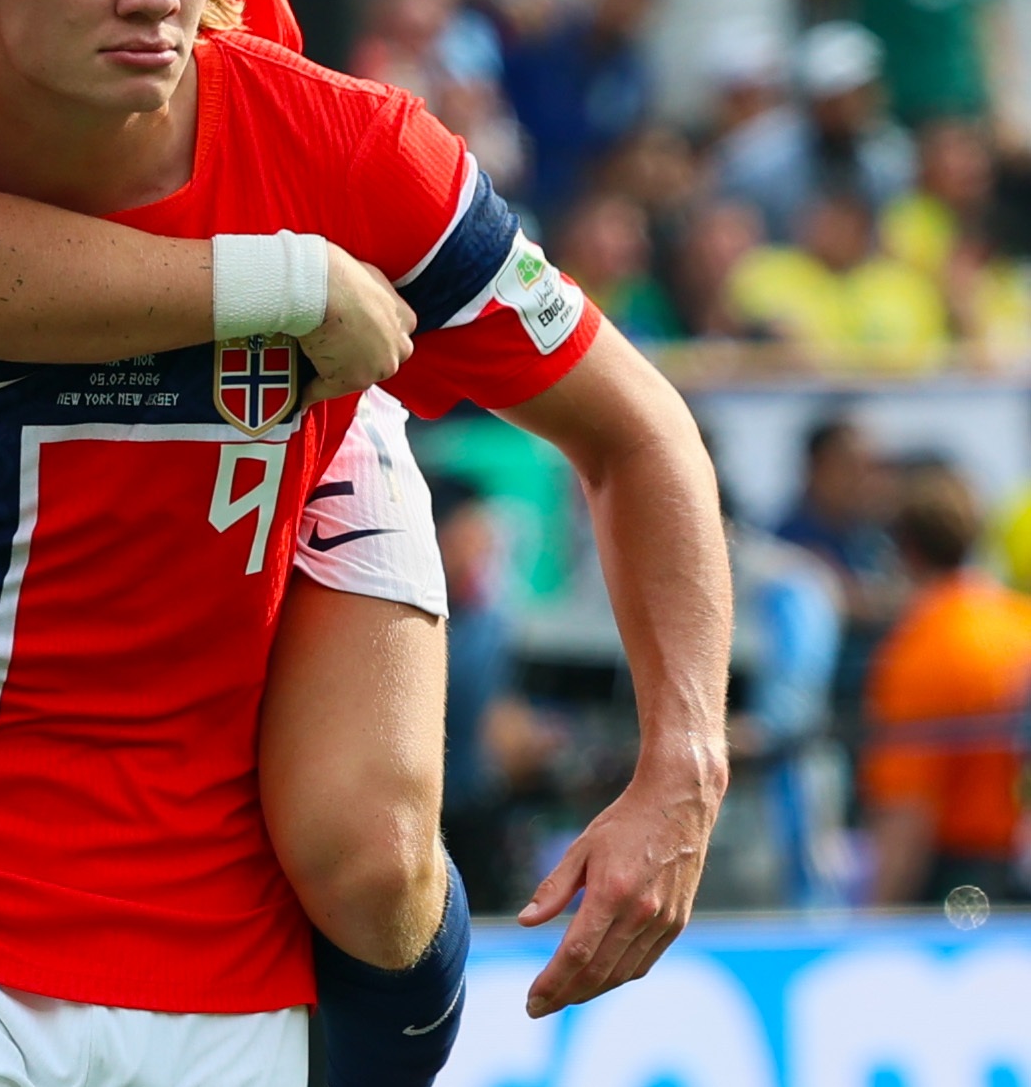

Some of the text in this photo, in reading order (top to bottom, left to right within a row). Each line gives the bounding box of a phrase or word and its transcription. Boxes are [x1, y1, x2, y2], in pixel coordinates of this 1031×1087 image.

[89, 373, 161, 386] 05.07.2026
[56, 392, 82, 406] NEW
[84, 392, 116, 406] YORK
[117, 392, 143, 406] NEW
[207, 442, 287, 576] 9
